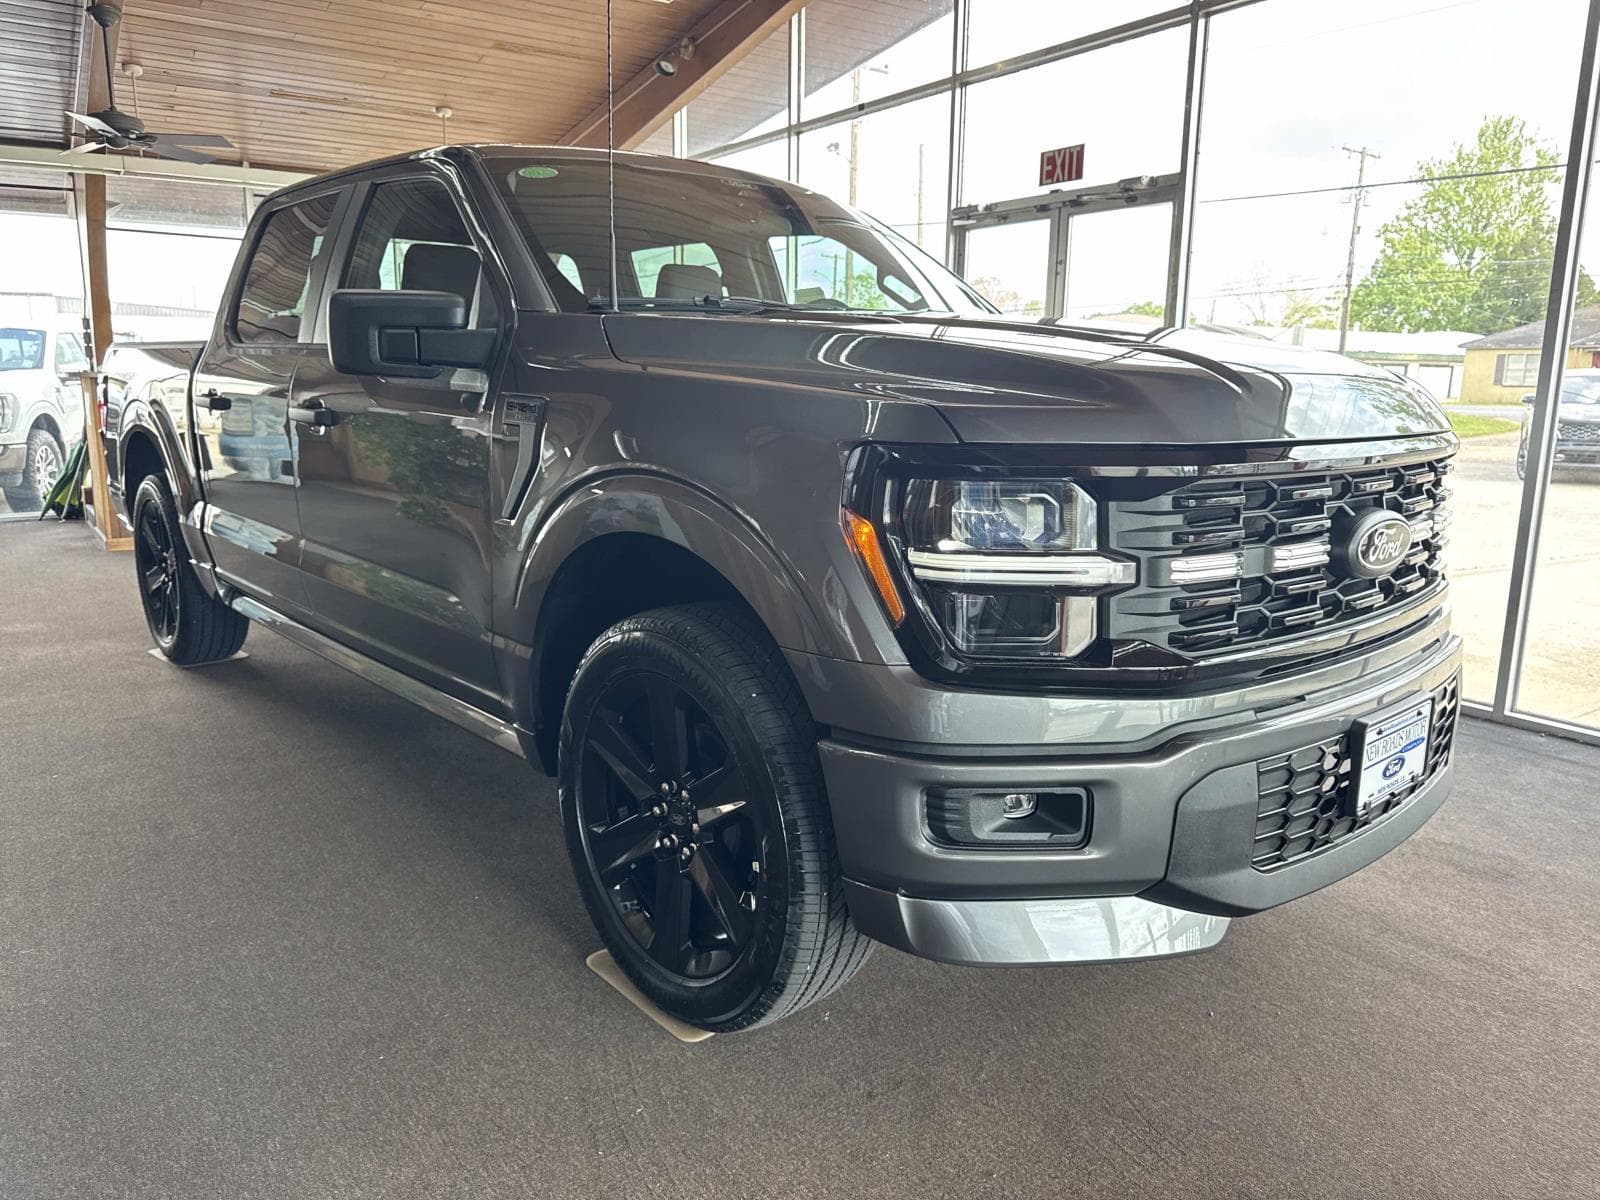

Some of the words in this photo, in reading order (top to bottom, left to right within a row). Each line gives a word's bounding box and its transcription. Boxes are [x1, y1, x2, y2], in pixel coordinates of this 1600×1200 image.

[1042, 146, 1081, 185] EXIT
[1369, 527, 1403, 562] Ford
[1365, 741, 1382, 763] NEW
[1381, 729, 1405, 756] ROADS
